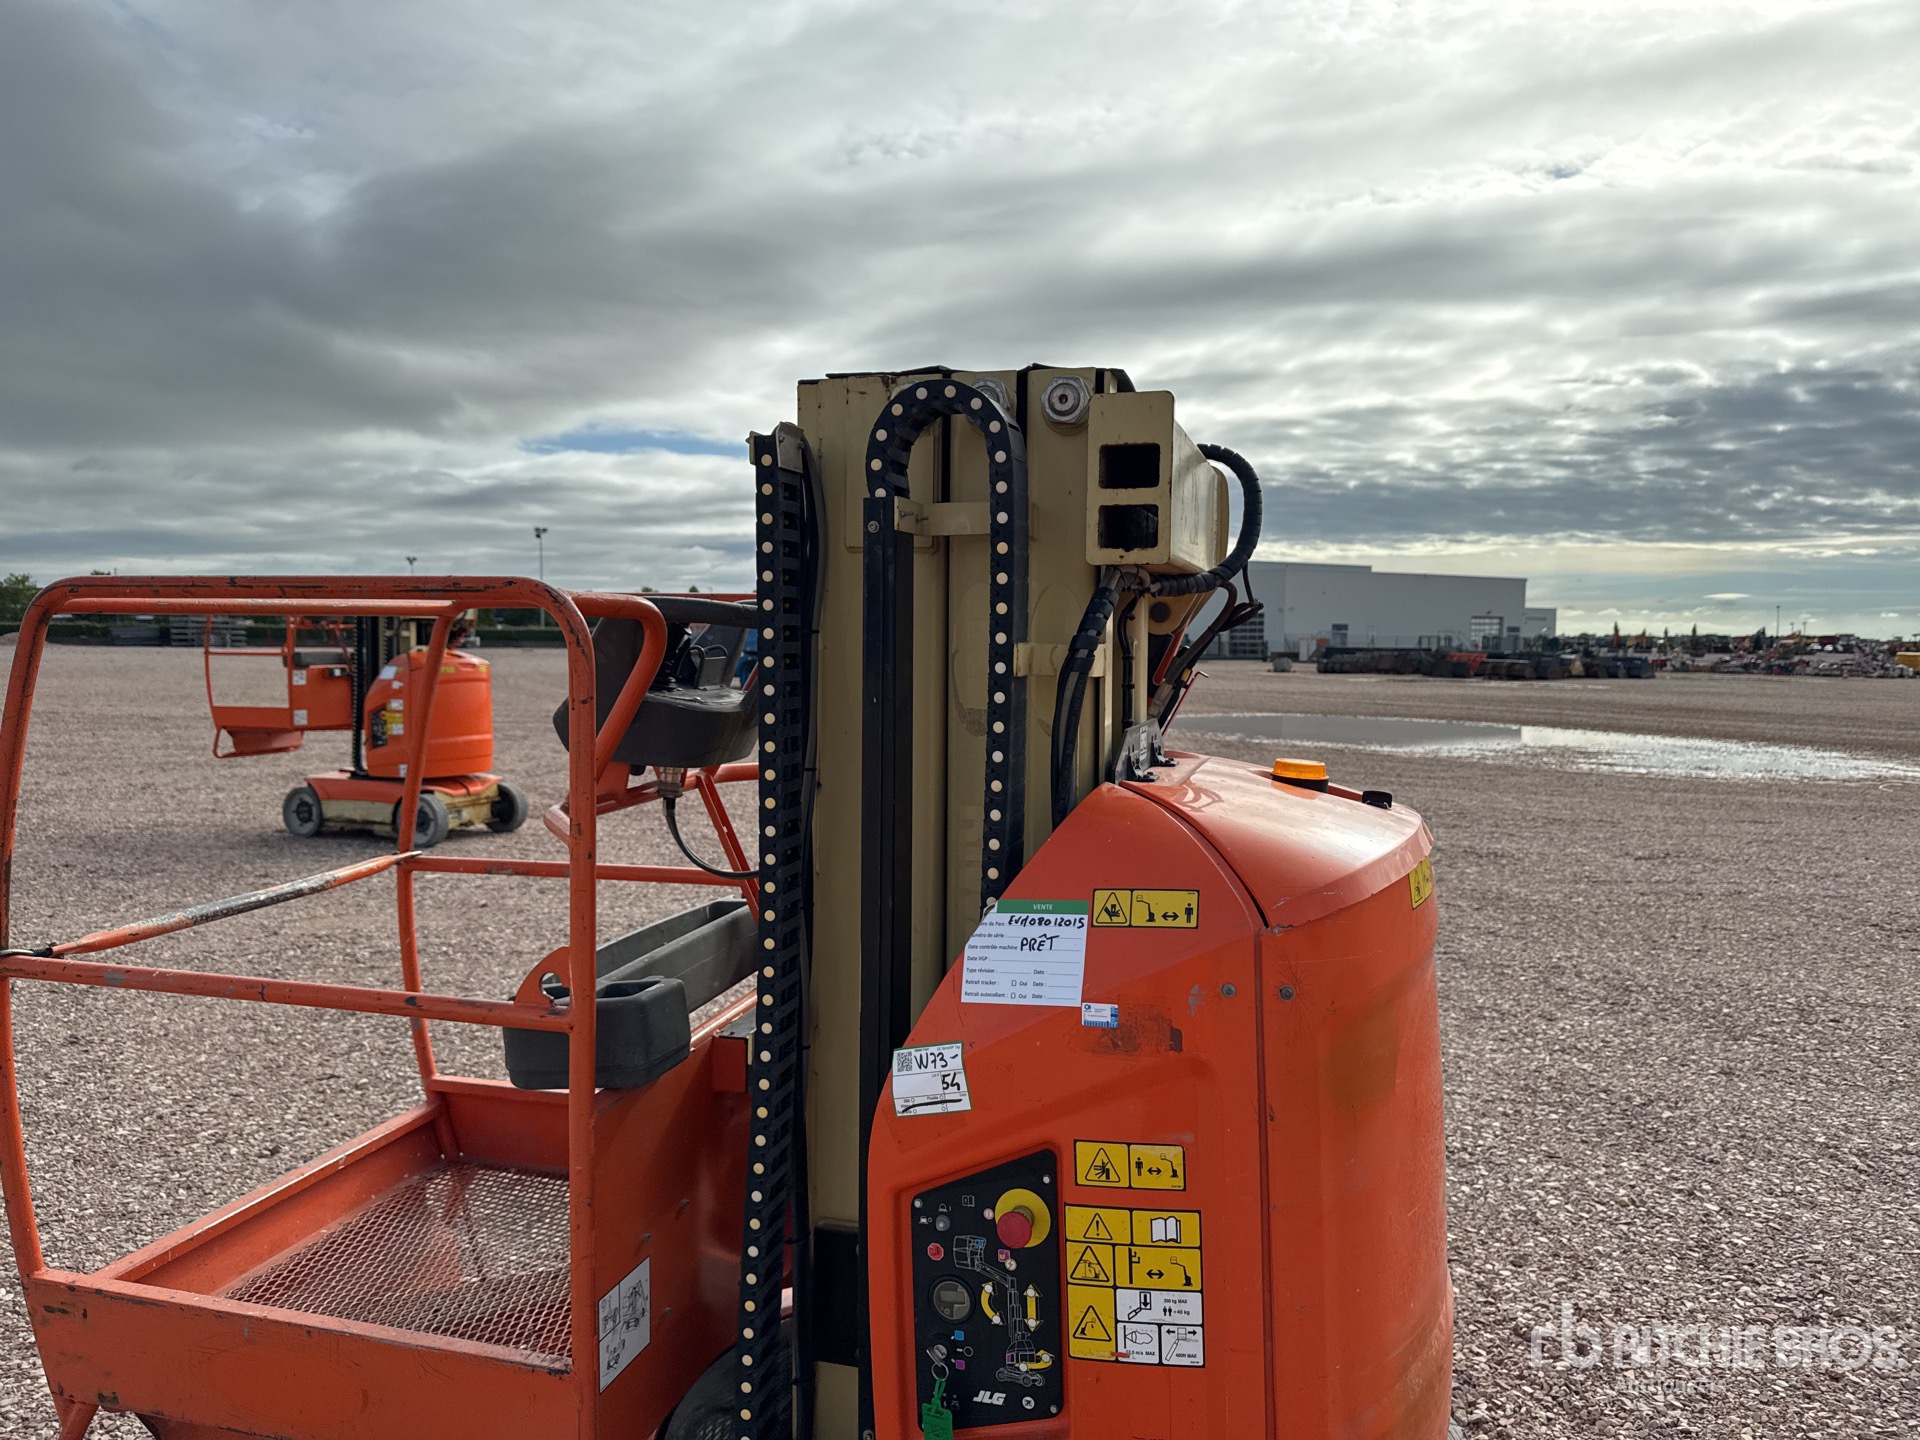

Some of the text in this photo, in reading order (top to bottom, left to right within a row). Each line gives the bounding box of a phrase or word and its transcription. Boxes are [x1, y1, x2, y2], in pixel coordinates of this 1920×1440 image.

[1020, 934, 1060, 952] PRÊT
[942, 1072, 960, 1091] 54
[972, 1390, 1006, 1406] JLG
